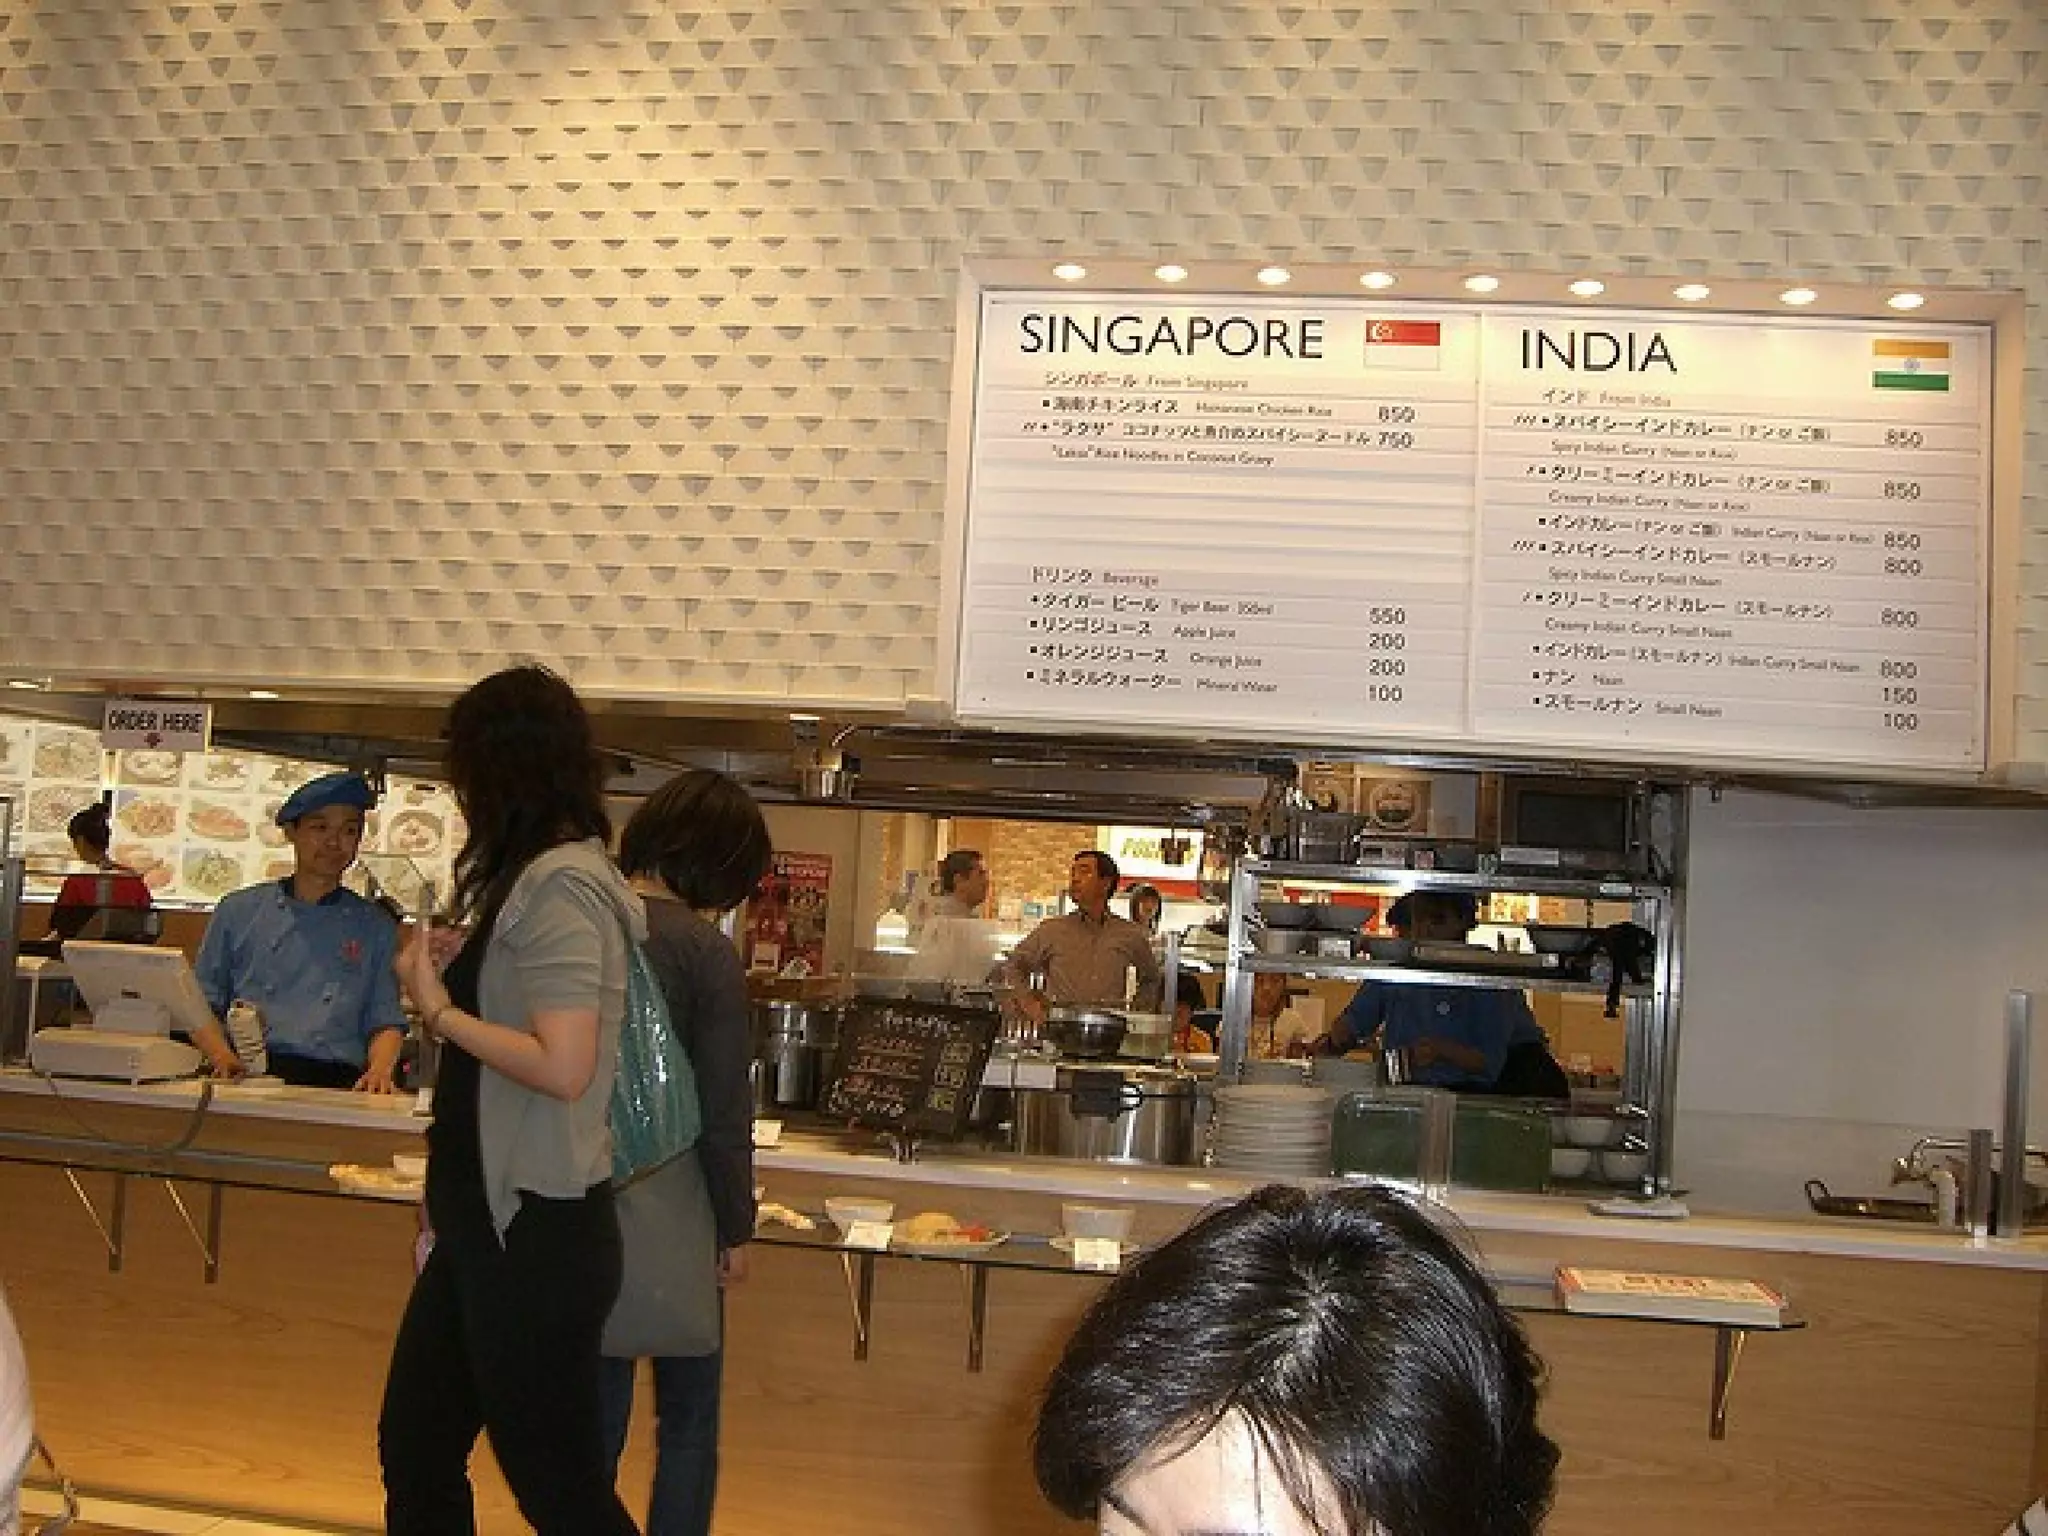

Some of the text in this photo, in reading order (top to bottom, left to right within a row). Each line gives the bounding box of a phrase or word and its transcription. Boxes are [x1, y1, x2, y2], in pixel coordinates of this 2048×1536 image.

[1020, 315, 1323, 358] SINGAPORE
[1522, 329, 1677, 372] INDIA
[1378, 406, 1416, 423] 850
[1379, 431, 1414, 448] 750
[1884, 428, 1924, 449] 850
[1884, 480, 1921, 500] 850
[1884, 531, 1921, 550] 850
[1884, 556, 1923, 576] 800
[1369, 607, 1406, 624] 550
[1881, 607, 1920, 627] 800
[1369, 632, 1406, 650] 200
[1369, 658, 1406, 676] 200
[1881, 659, 1918, 679] 800
[1368, 684, 1403, 702] 100
[1883, 686, 1918, 705] 150
[109, 709, 202, 733] ORDER HERE
[1883, 712, 1918, 731] 100
